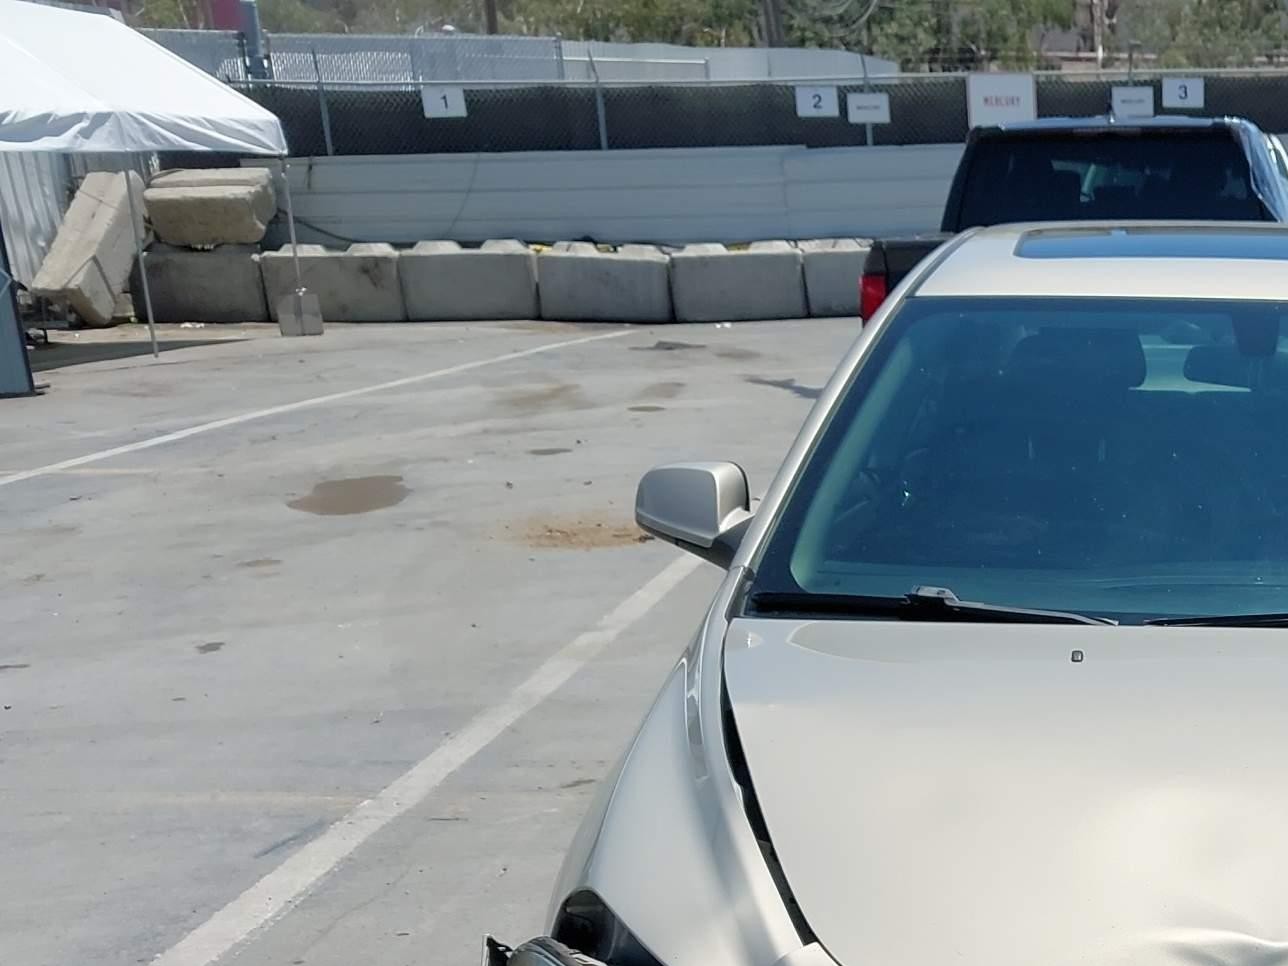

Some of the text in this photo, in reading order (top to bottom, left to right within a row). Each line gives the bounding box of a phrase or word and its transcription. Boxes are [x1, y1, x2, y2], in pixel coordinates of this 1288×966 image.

[1178, 84, 1189, 100] 3
[440, 93, 449, 110] 1
[812, 92, 823, 110] 2
